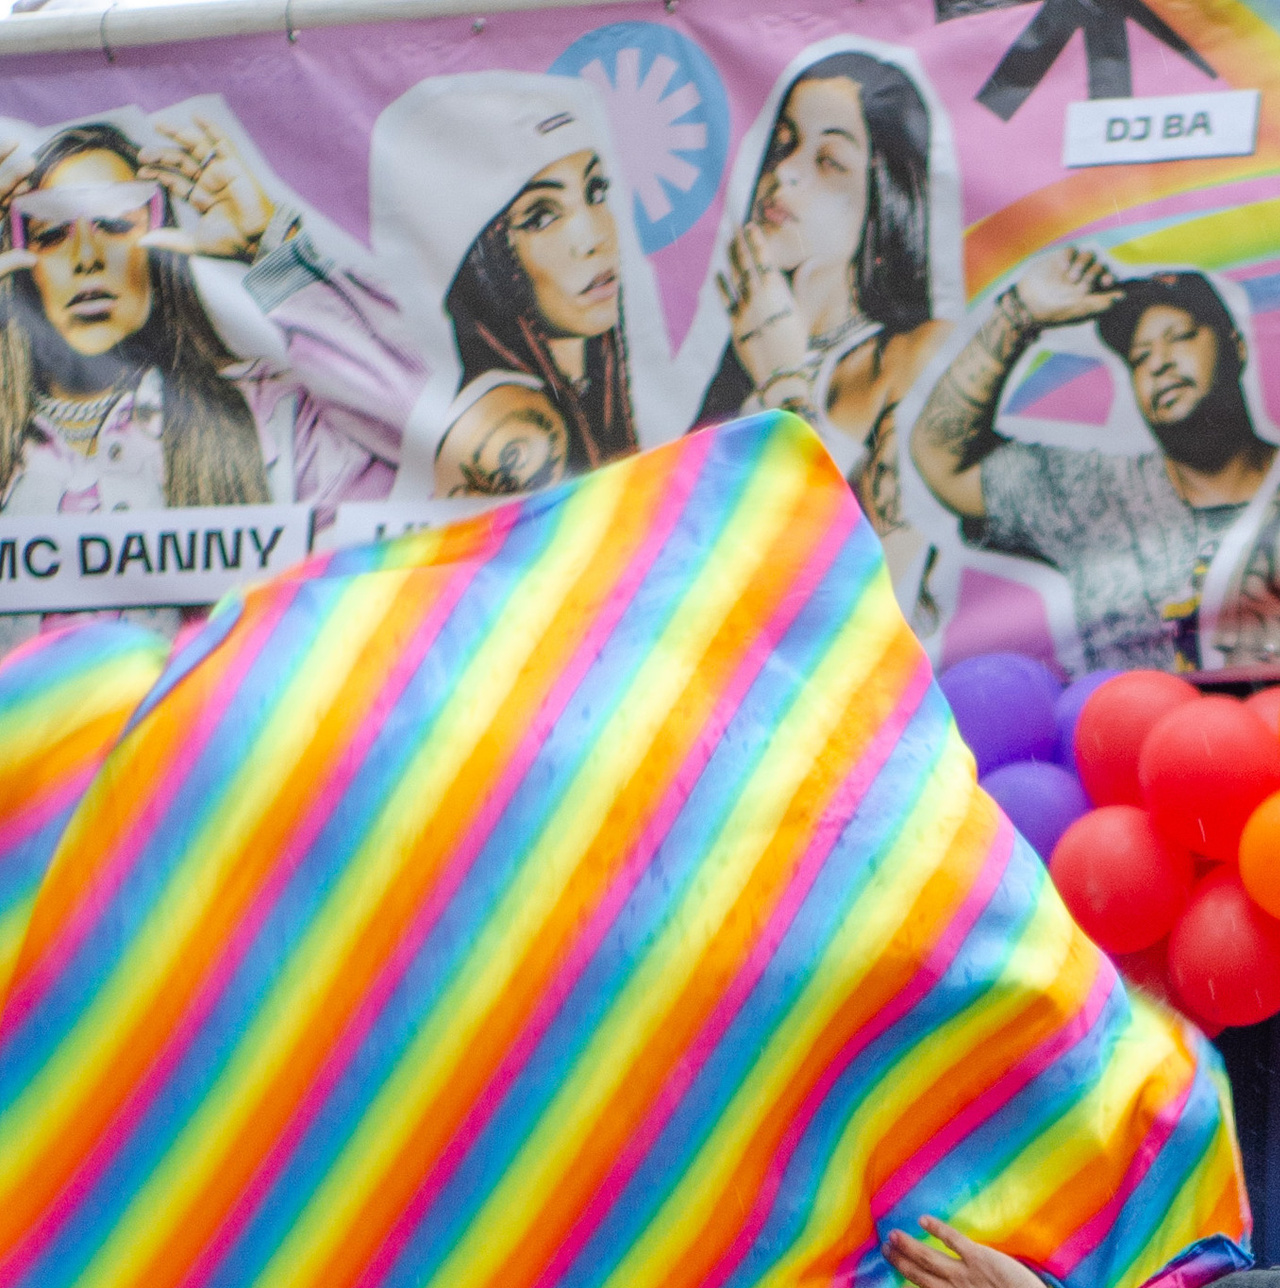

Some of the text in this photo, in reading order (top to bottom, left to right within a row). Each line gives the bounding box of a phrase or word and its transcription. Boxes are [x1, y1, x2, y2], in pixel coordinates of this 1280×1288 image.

[1105, 111, 1213, 143] DJ BA
[78, 527, 284, 575] DANNY
